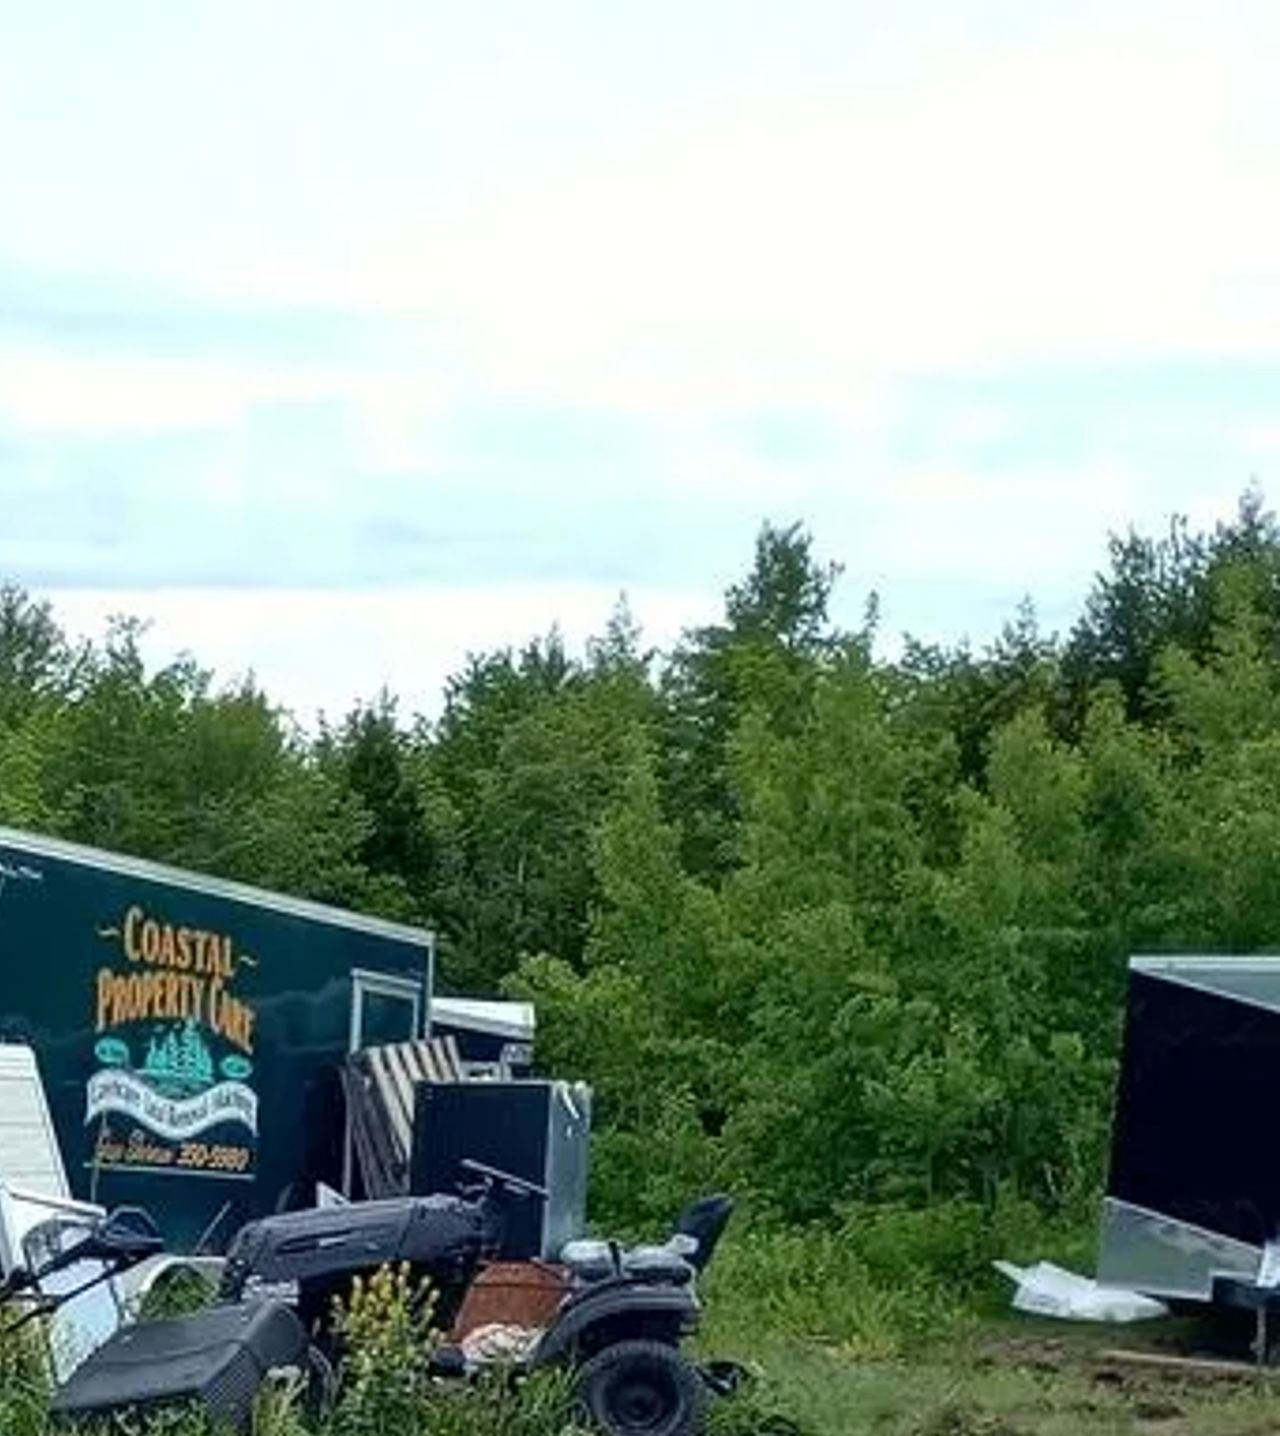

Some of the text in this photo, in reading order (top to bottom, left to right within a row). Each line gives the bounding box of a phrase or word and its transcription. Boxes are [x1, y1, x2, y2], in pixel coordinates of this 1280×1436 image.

[123, 905, 237, 978] COASTAL
[93, 966, 257, 1055] PROPERTY CARE
